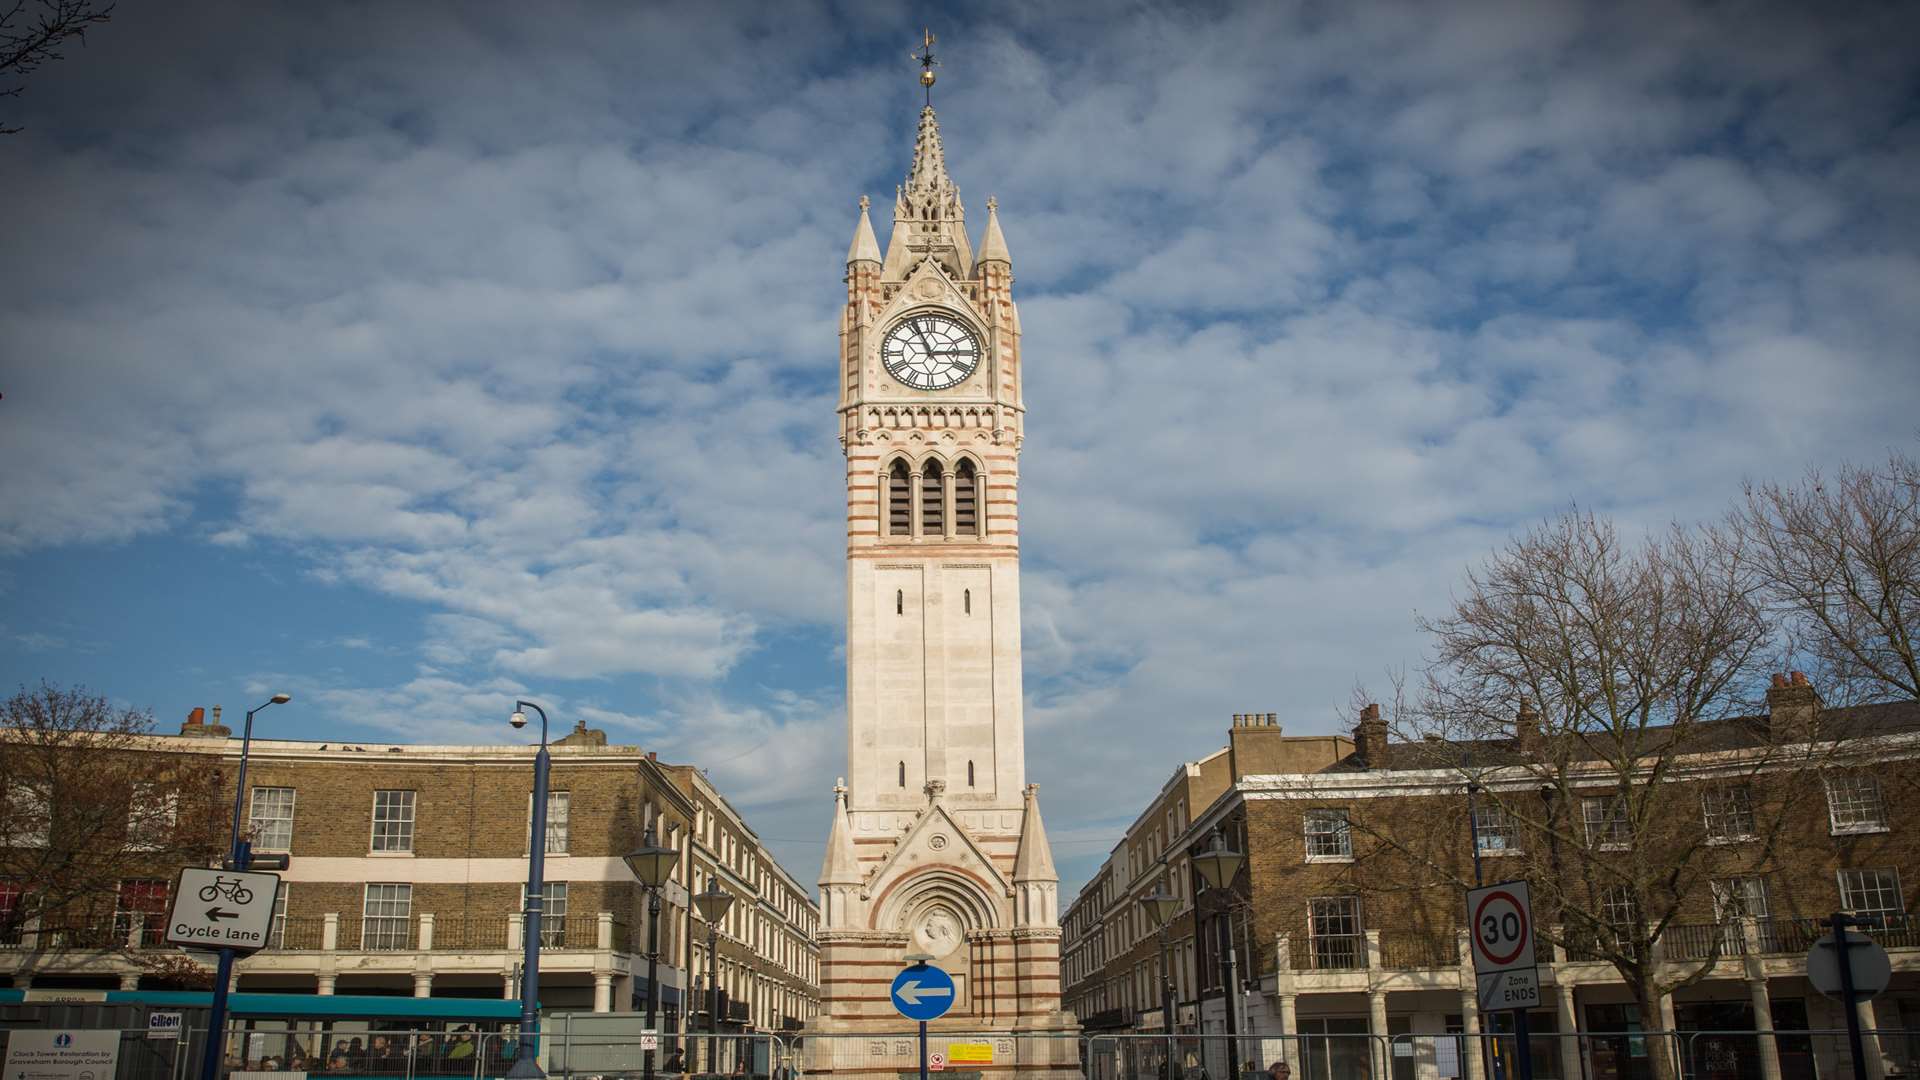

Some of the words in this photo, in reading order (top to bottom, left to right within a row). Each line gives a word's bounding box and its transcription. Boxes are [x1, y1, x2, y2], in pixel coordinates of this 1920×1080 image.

[175, 923, 220, 938] Cycle
[226, 927, 260, 941] lane
[1482, 911, 1520, 945] 30
[1508, 976, 1529, 986] Zone
[1504, 987, 1536, 1002] ENDS
